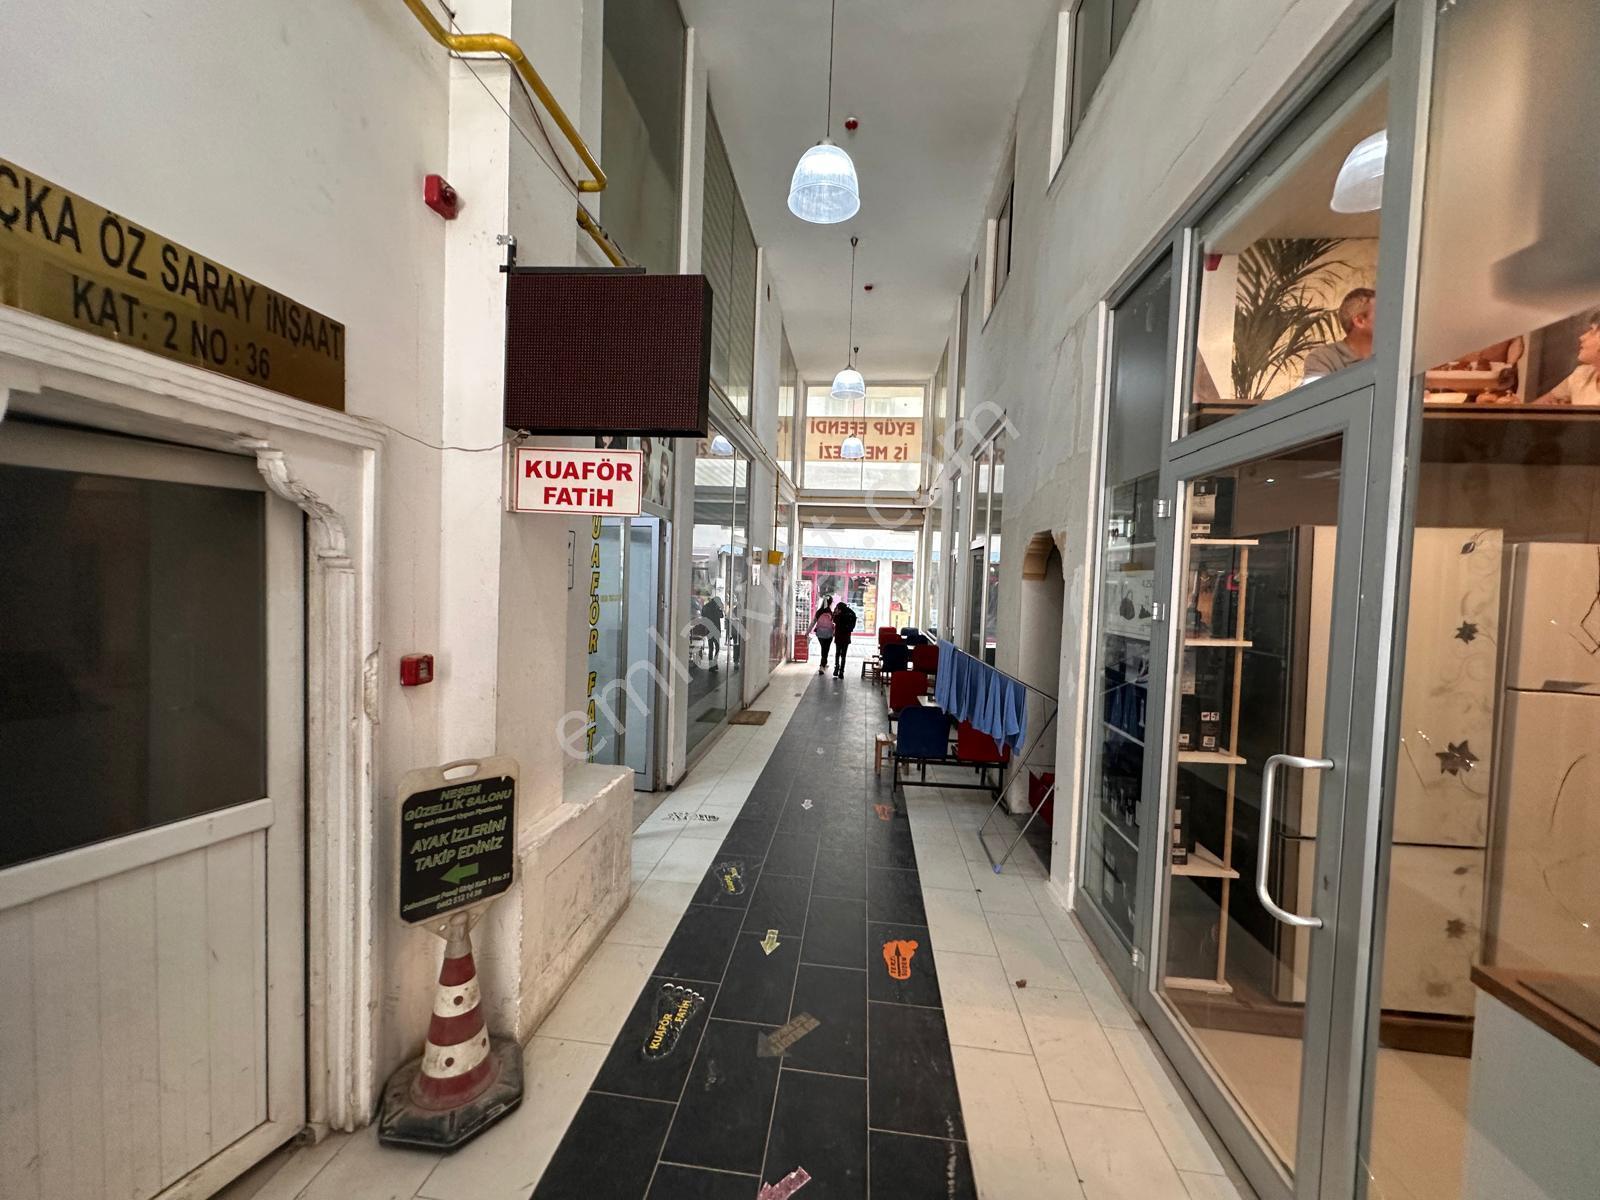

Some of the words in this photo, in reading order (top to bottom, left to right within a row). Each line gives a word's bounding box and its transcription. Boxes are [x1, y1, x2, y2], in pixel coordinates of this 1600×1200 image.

[100, 211, 148, 280] ÖZ
[161, 244, 256, 324] SARAY
[164, 311, 179, 351] 2
[245, 342, 271, 380] 36
[525, 458, 633, 481] KUAFÖR
[588, 514, 602, 655] UAFÖR
[404, 797, 466, 821] GÜZELLİK
[466, 789, 512, 807] SALONU
[410, 831, 451, 855] AYAK
[450, 816, 507, 843] İZLERİNİ
[415, 849, 456, 872] TAKİP
[457, 836, 504, 860] EDİNİZ
